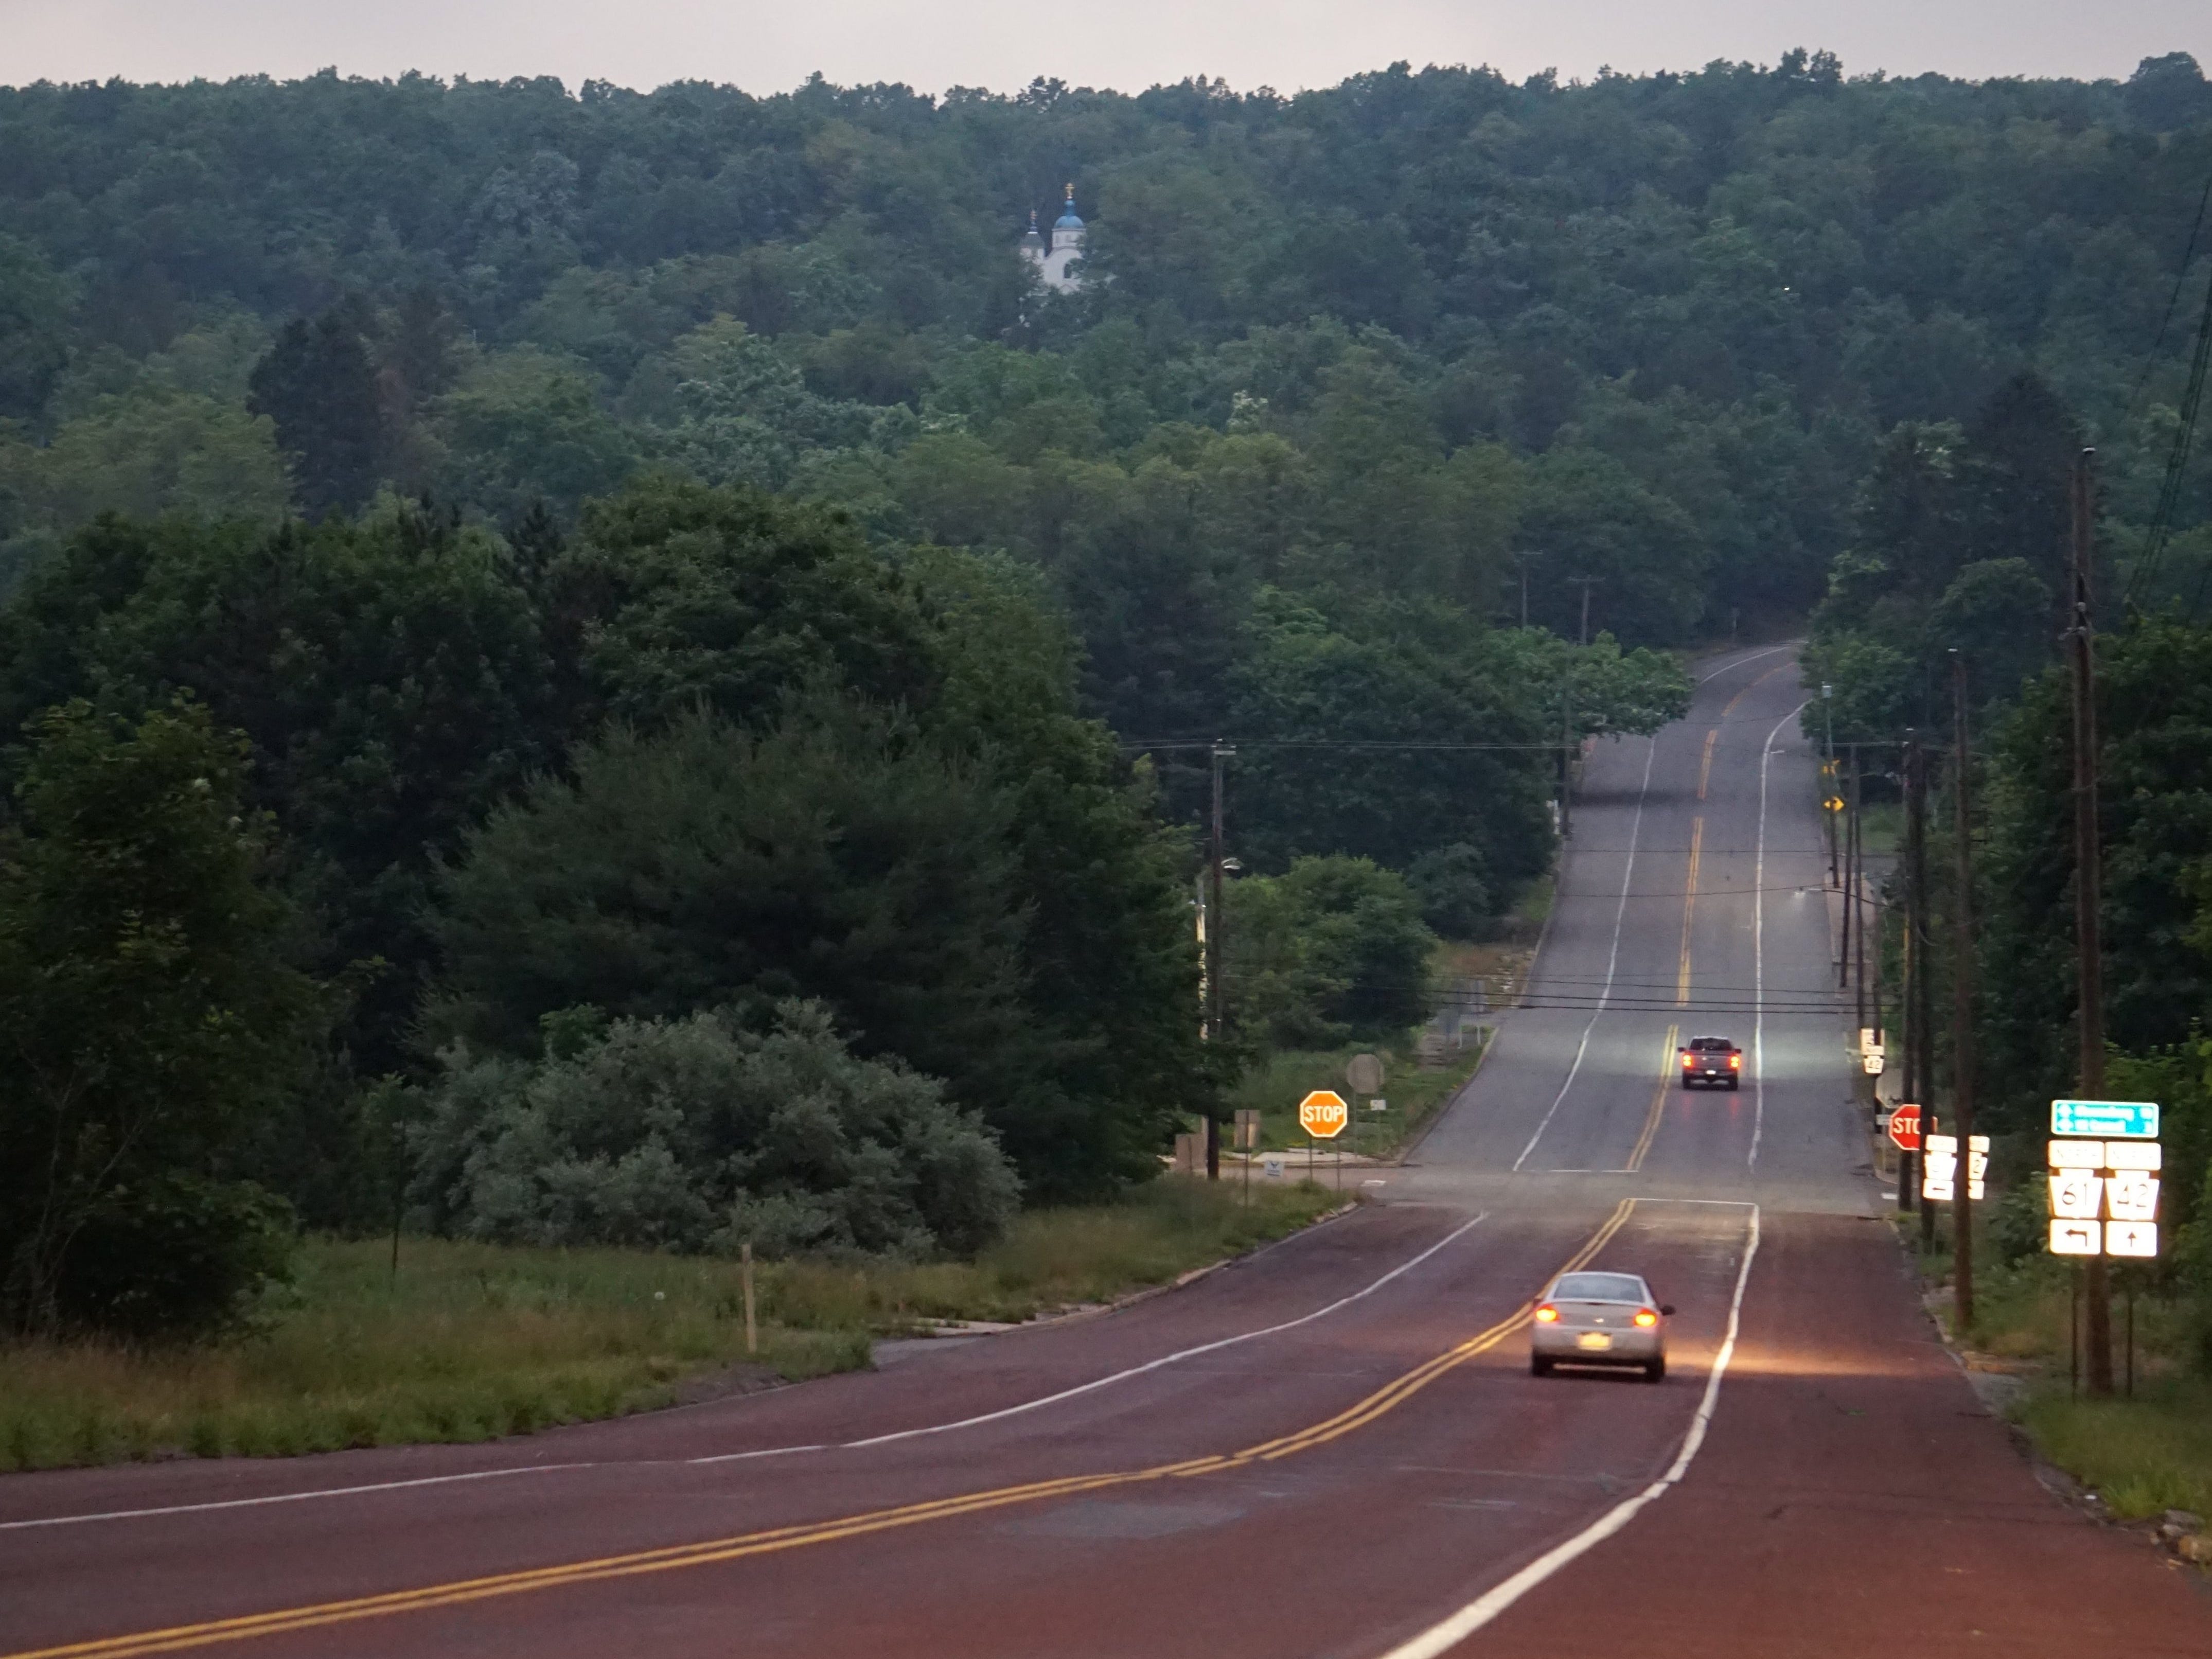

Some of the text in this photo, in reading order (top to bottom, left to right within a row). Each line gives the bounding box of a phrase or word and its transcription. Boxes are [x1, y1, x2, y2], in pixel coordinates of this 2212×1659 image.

[1304, 1106, 1343, 1122] STOP
[1893, 1118, 1920, 1134] STO
[2062, 1183, 2088, 1206] 61
[2116, 1183, 2148, 1208] 42
